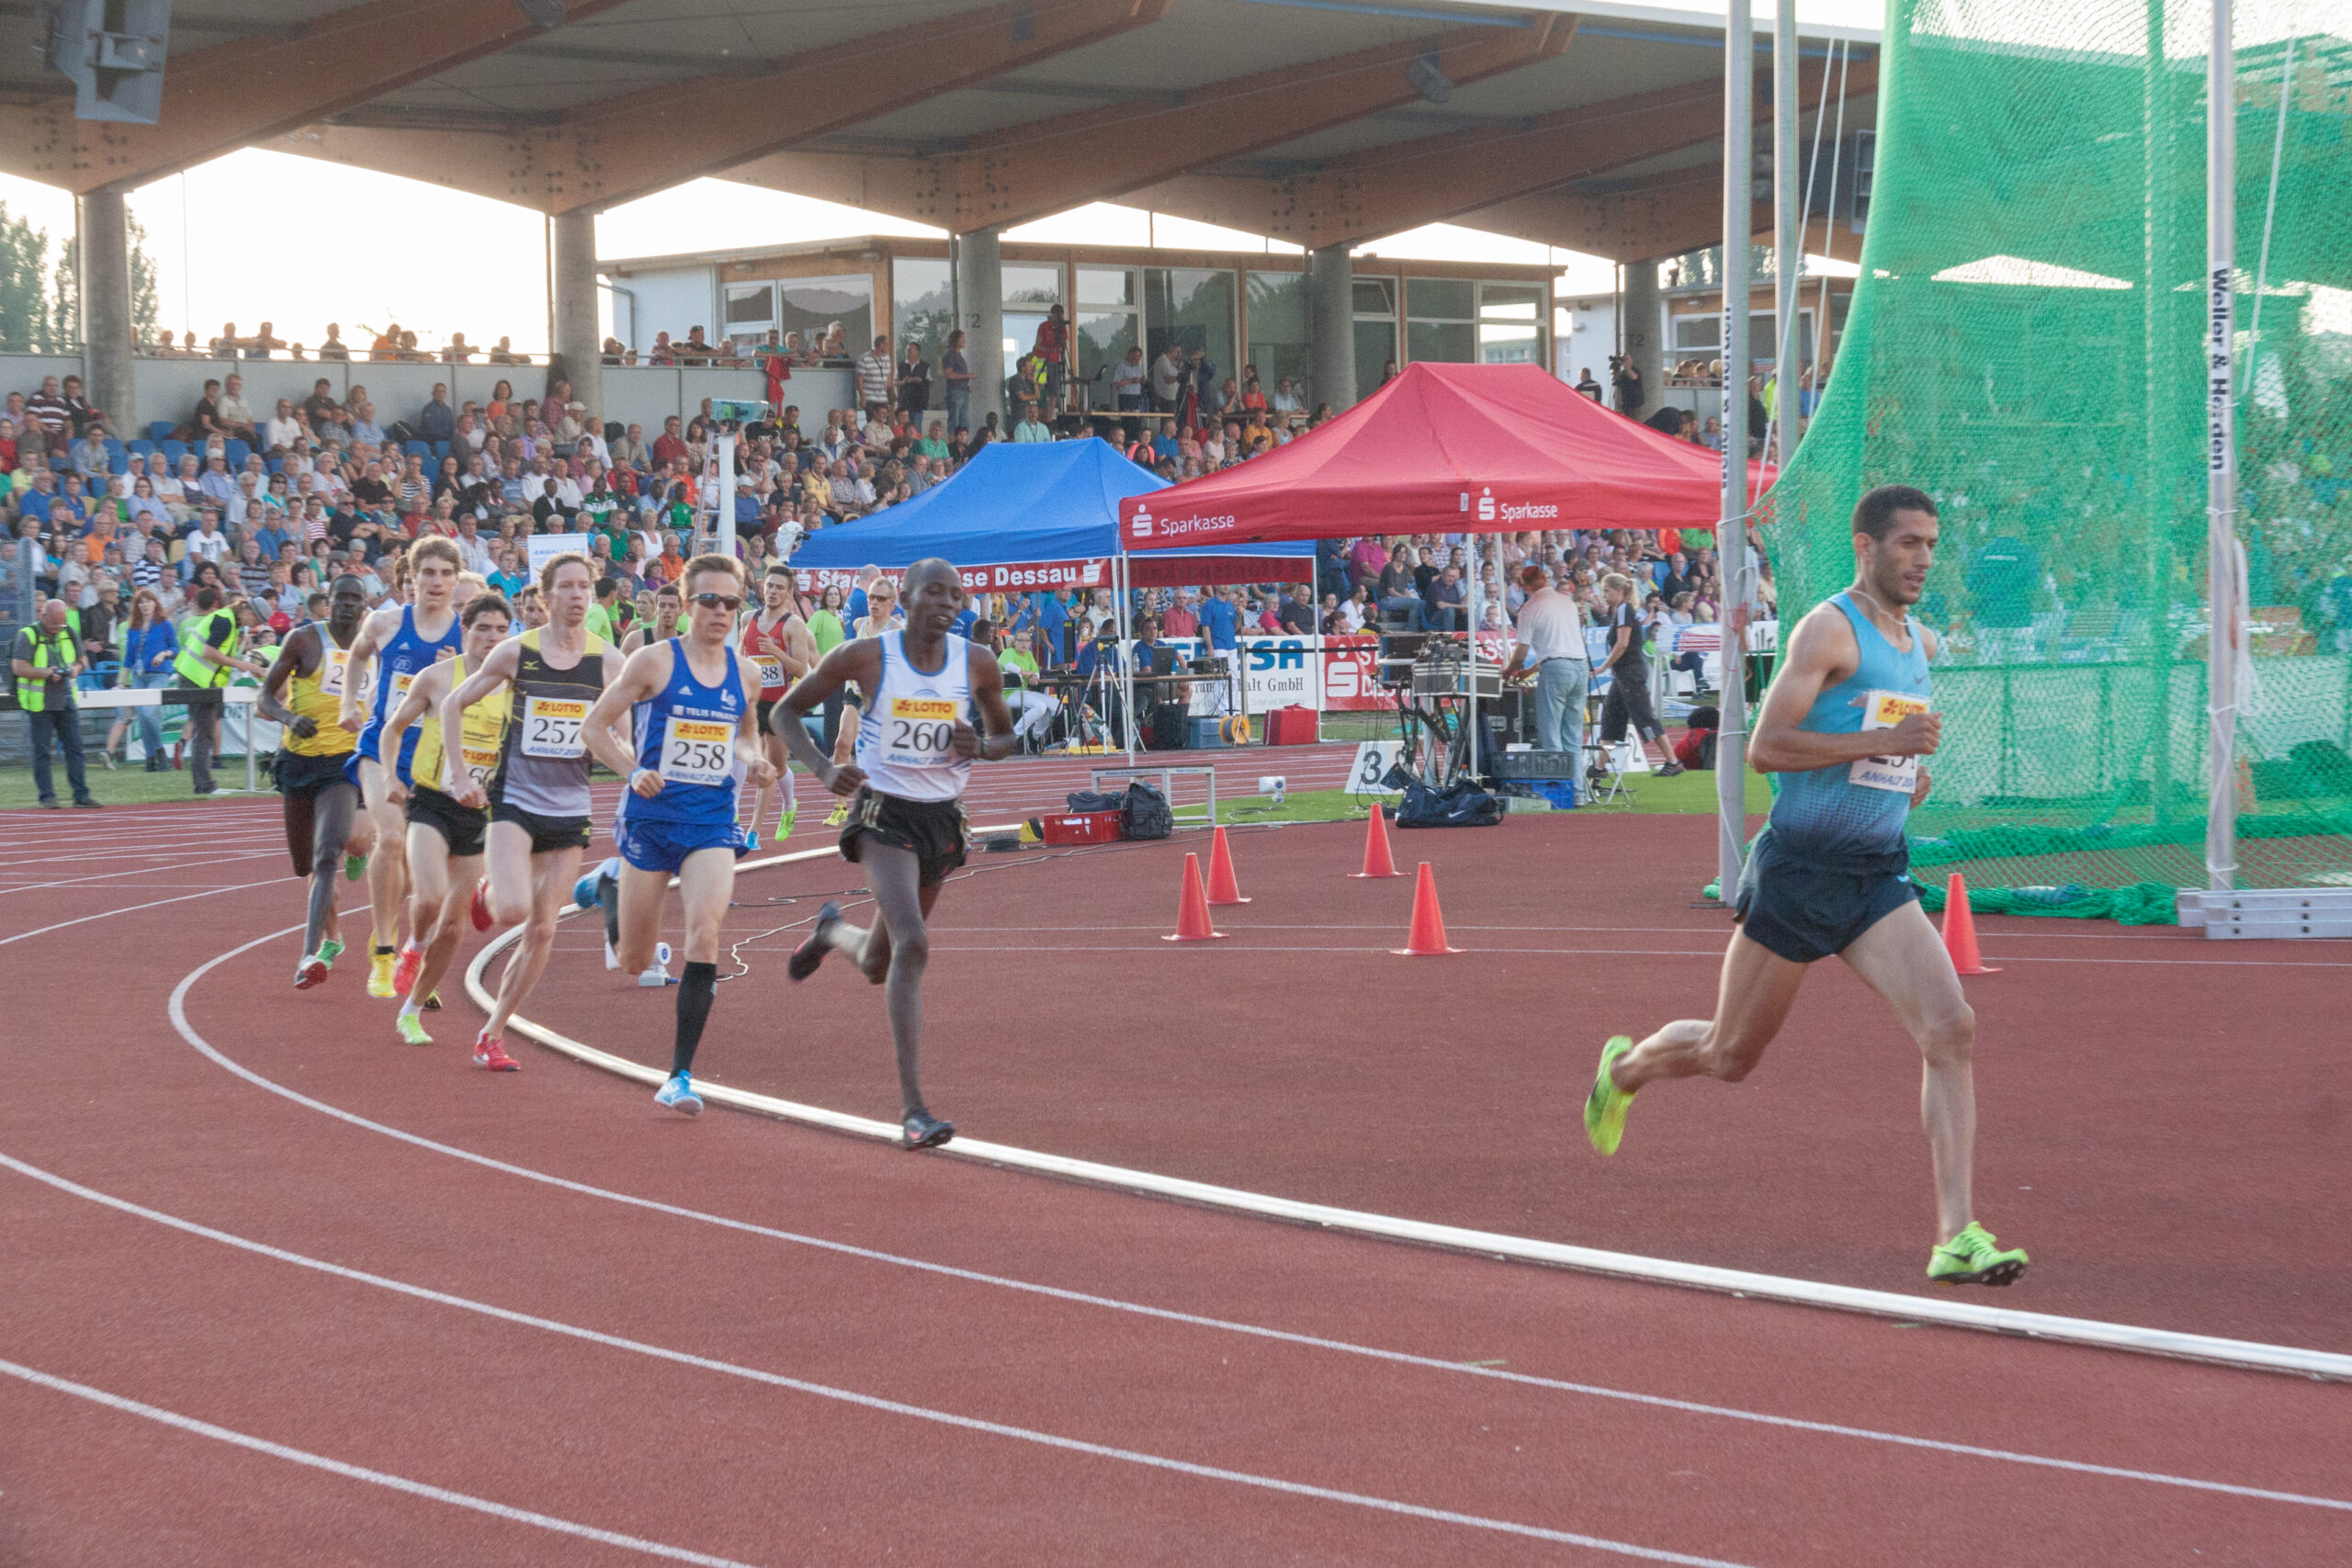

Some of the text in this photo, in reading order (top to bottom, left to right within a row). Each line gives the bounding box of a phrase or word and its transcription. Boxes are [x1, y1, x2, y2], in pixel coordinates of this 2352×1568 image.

[2211, 268, 2228, 347] Weller
[2211, 353, 2228, 369] &
[1500, 502, 1558, 524] Sparkasse
[1160, 514, 1236, 536] Sparkasse
[995, 566, 1077, 586] Dessau
[1268, 677, 1304, 692] GmbH
[551, 704, 582, 714] LOTTO
[685, 706, 709, 717] TELIS
[914, 702, 952, 714] LOTTO
[531, 718, 581, 744] 257
[695, 726, 726, 736] LOTTO
[891, 720, 953, 751] 260
[672, 740, 726, 770] 258
[1361, 750, 1382, 784] 3
[1859, 771, 1902, 785] ANHALT
